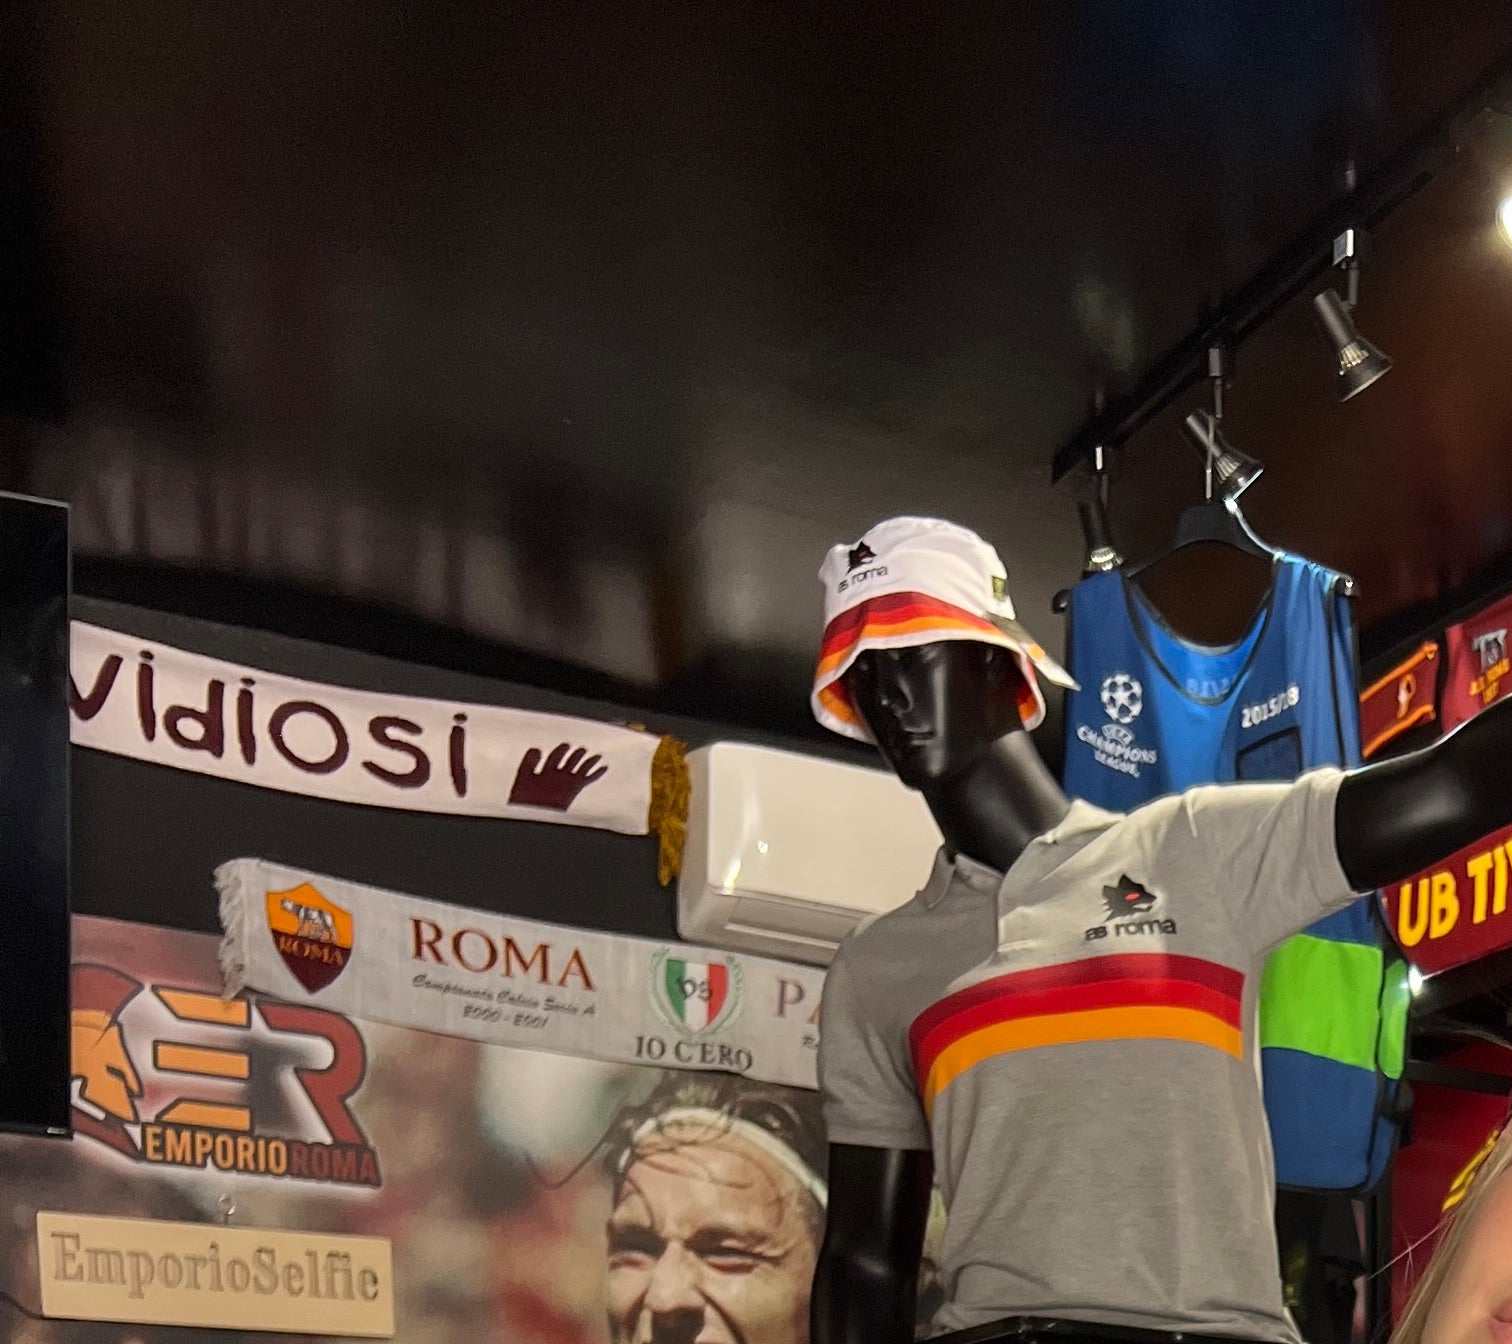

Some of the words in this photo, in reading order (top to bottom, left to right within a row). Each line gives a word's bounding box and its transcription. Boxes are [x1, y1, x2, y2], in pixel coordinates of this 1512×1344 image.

[1115, 917, 1177, 937] roma
[280, 936, 345, 966] ROMA
[410, 916, 597, 992] ROMA
